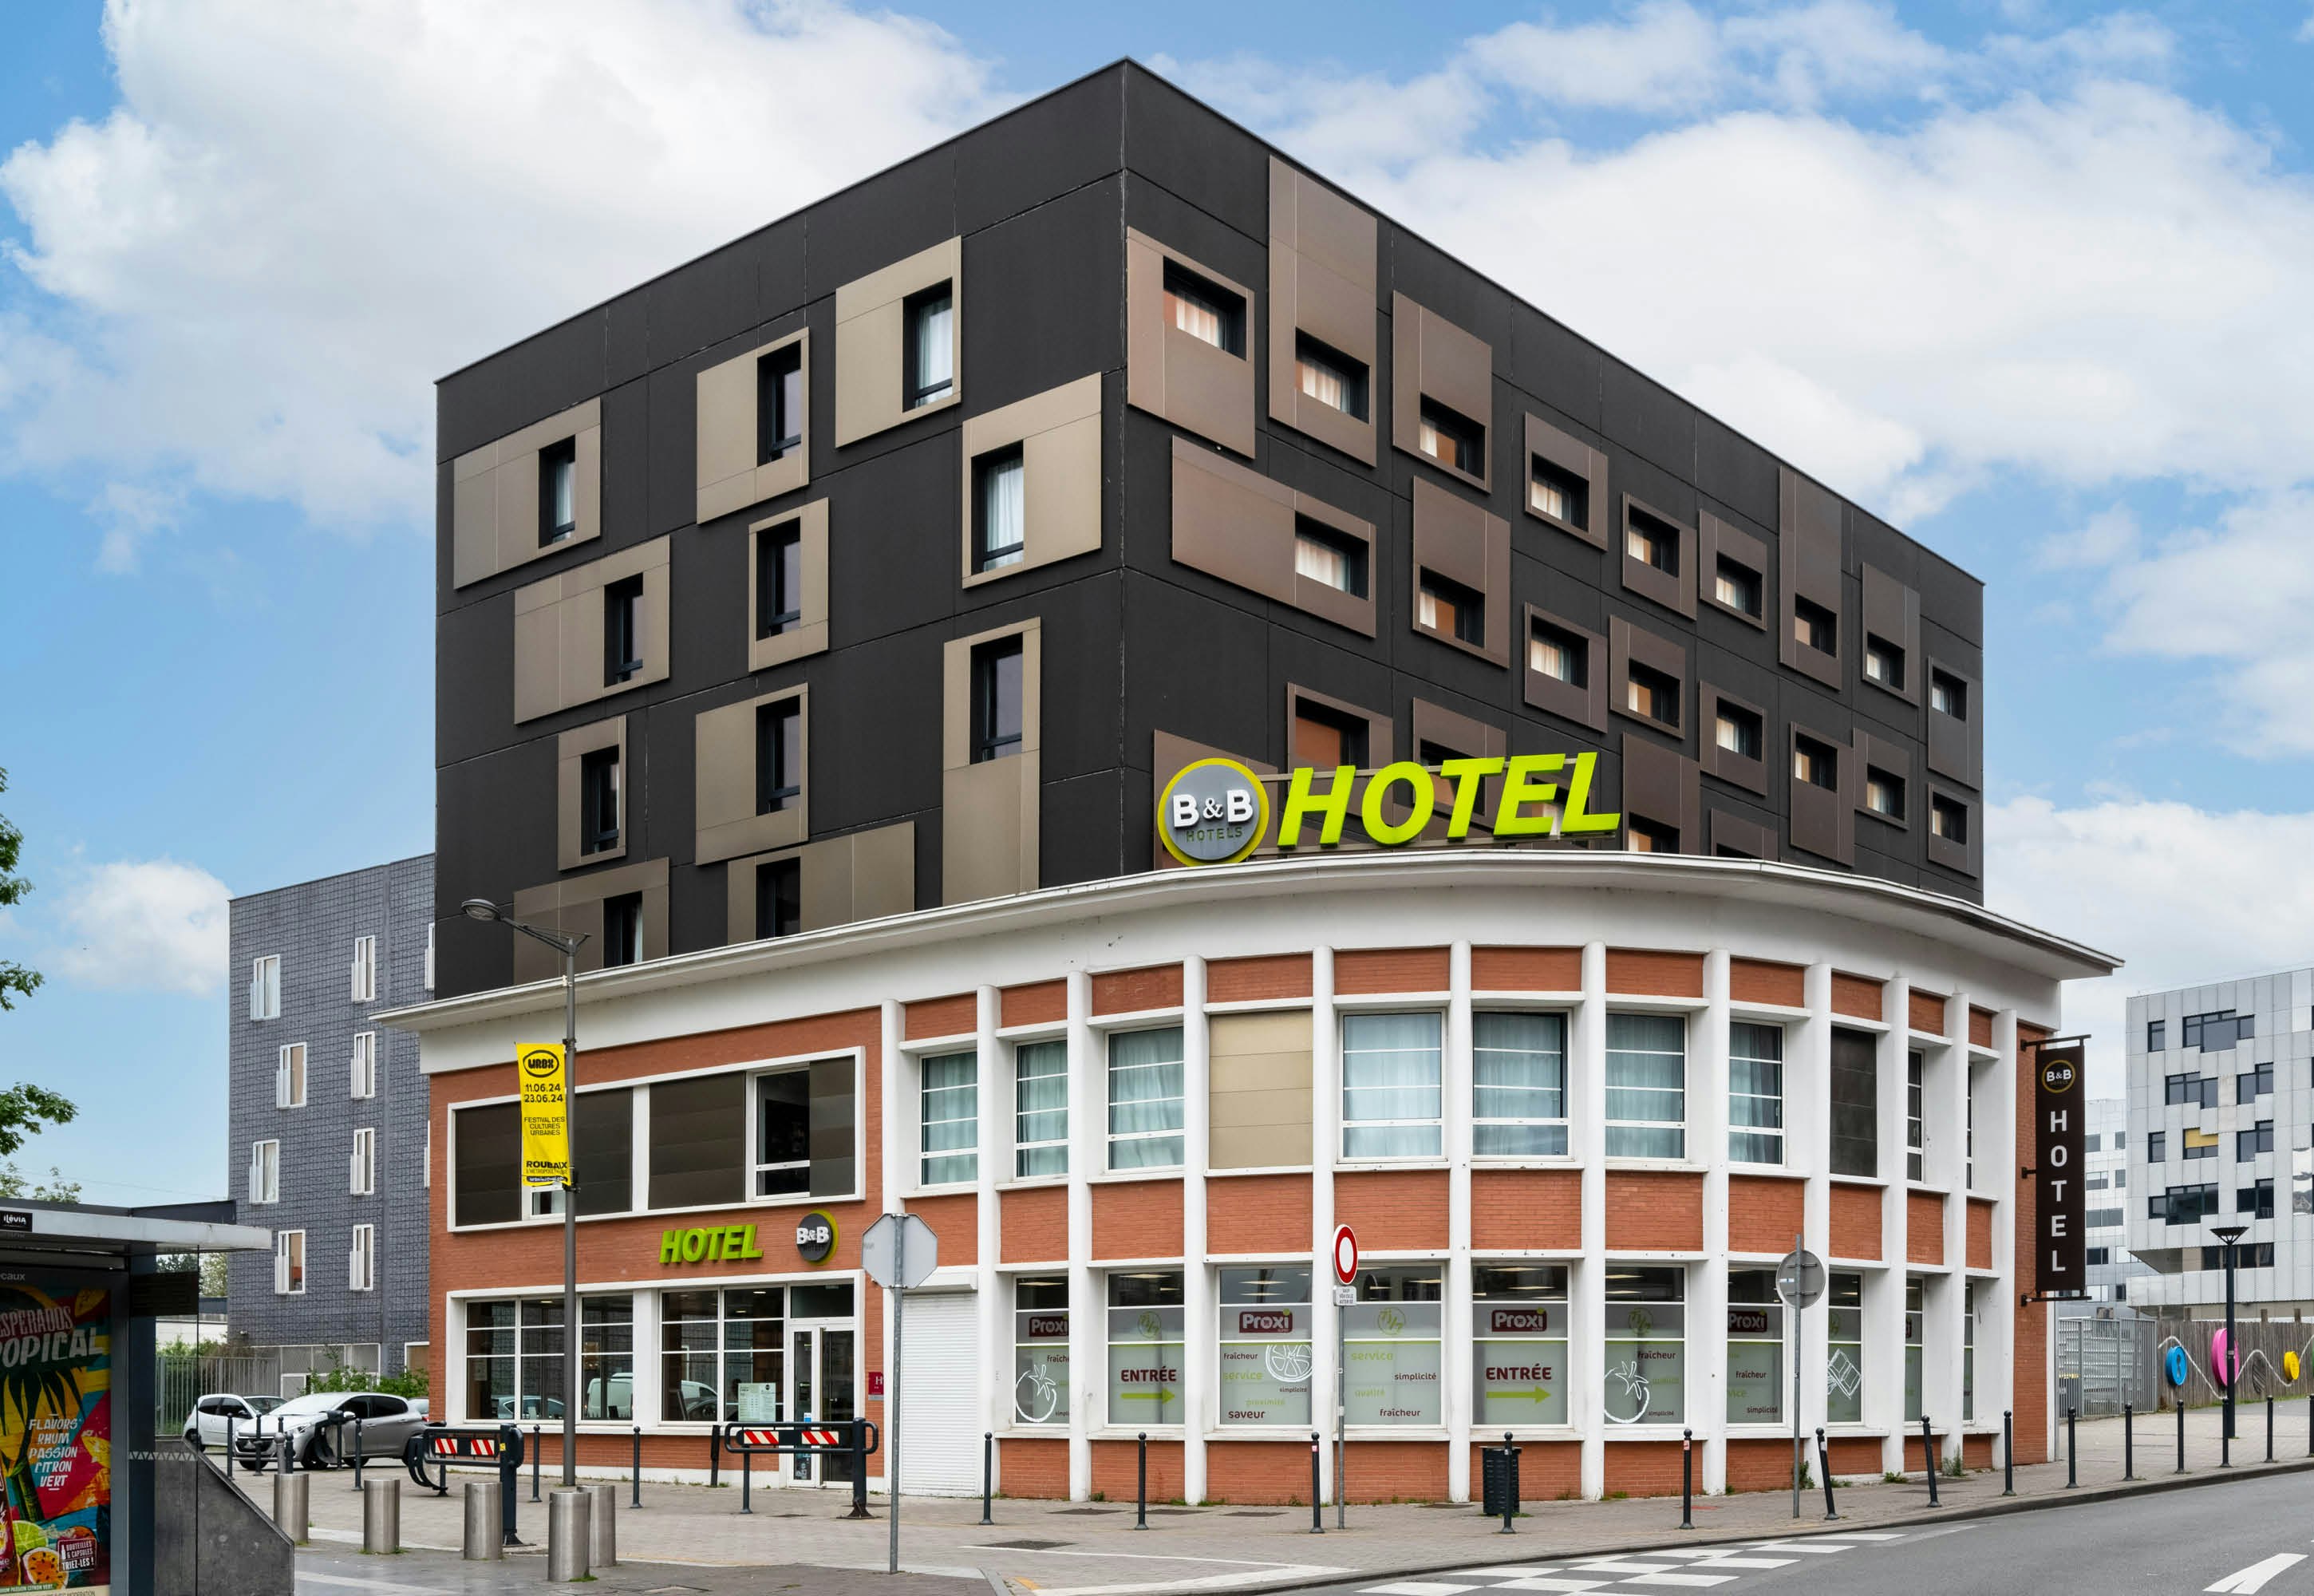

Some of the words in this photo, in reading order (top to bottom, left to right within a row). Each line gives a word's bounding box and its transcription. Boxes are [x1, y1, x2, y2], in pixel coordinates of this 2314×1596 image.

[1173, 788, 1254, 828] B&B
[1277, 752, 1621, 849] HOTEL
[1186, 826, 1243, 843] HOTELS
[2047, 1069, 2071, 1082] B&B
[2050, 1110, 2067, 1271] HOTEL
[659, 1224, 764, 1263] HOTEL
[796, 1226, 830, 1244] B&B
[1242, 1309, 1289, 1329] Proxi
[1495, 1307, 1544, 1328] Proxi
[1729, 1309, 1766, 1329] Proxi
[0, 1327, 103, 1368] OPICAL
[1121, 1366, 1176, 1381] ENTRÉE
[1486, 1363, 1551, 1380] ENTRÉE
[1747, 1405, 1778, 1414] simplicité
[38, 1432, 69, 1444] RHUM
[28, 1447, 77, 1460] PASSION
[34, 1460, 72, 1473] CITRON
[40, 1475, 68, 1487] VERT
